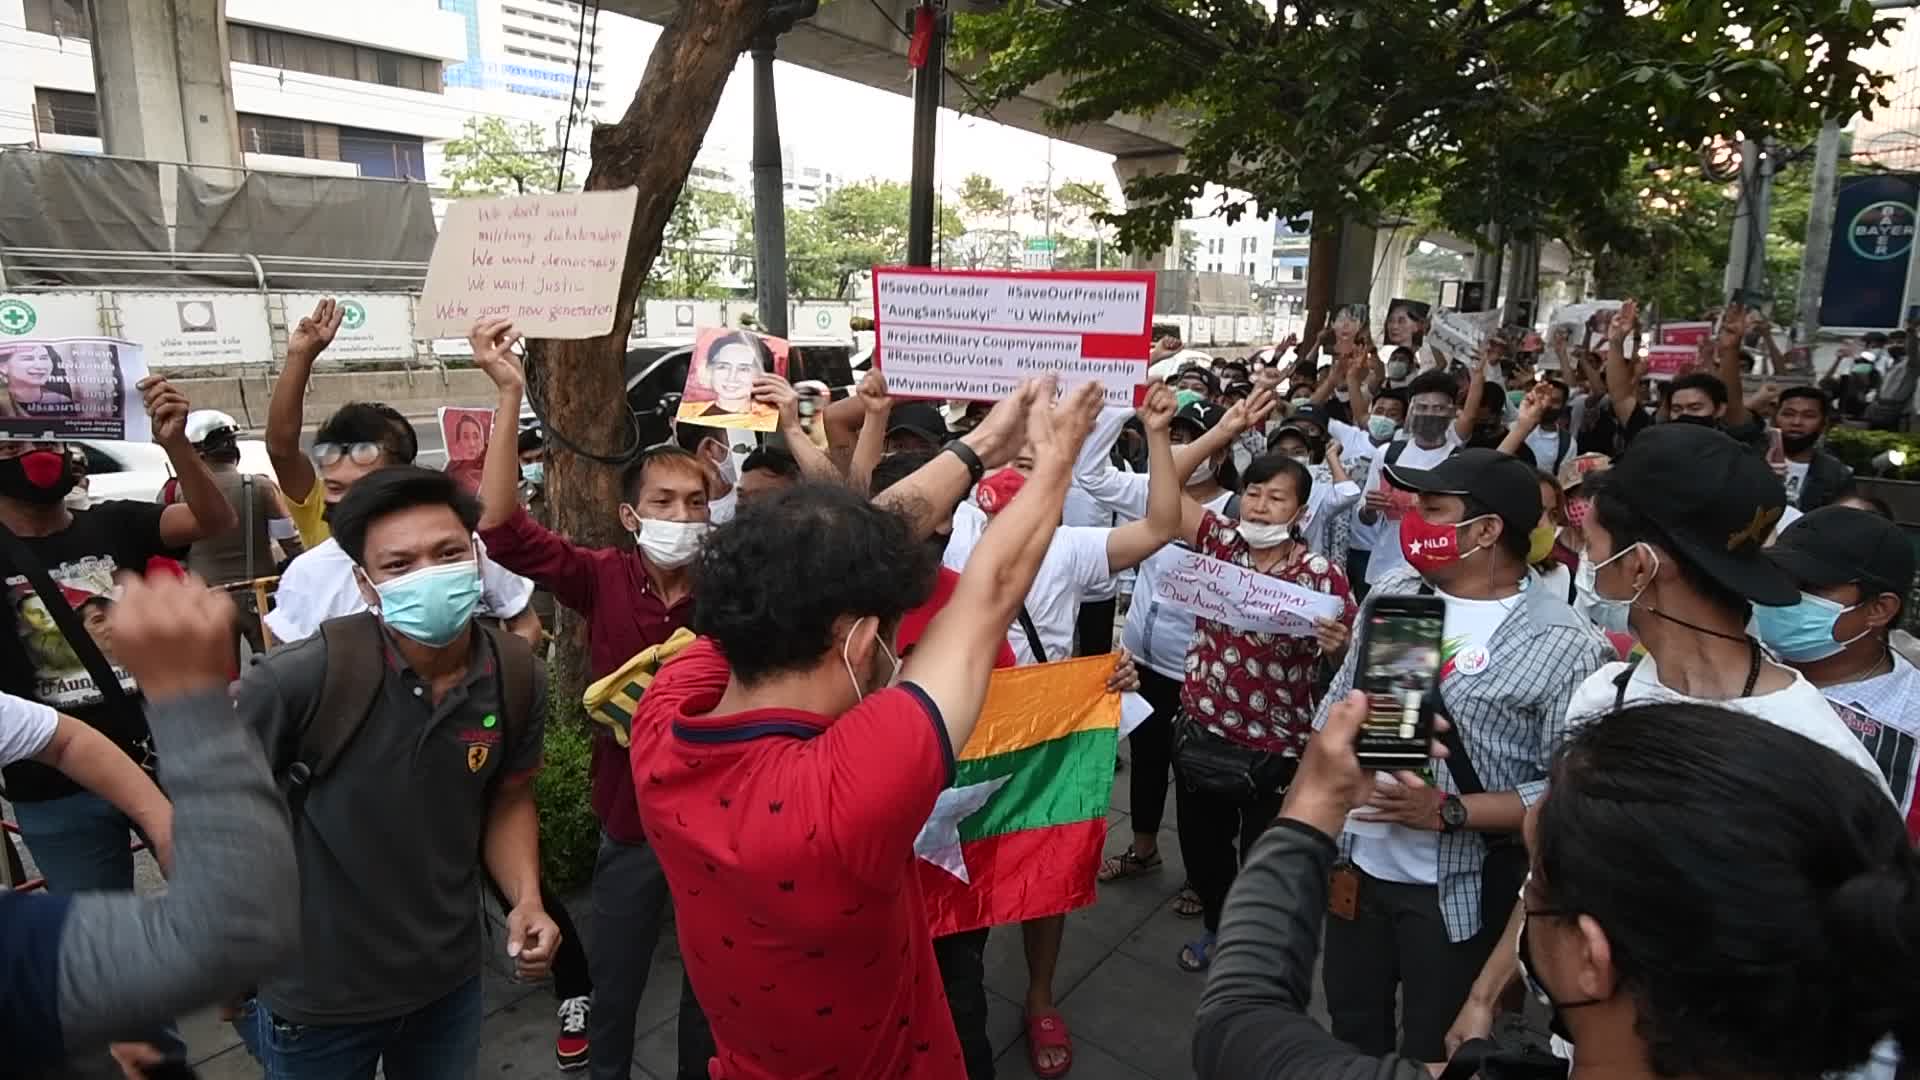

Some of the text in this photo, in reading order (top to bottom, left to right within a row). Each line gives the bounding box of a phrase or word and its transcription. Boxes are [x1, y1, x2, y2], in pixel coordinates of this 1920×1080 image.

[1856, 224, 1913, 236] BAYER
[472, 247, 494, 267] We
[502, 252, 535, 266] want
[467, 272, 486, 292] We
[494, 273, 526, 291] want
[881, 282, 1140, 302] #SaveOurLeader #SaveOurPresident
[886, 330, 1078, 351] #rejectMilitary Coupmyanmar
[887, 350, 1135, 376] #RespectOurVotes #StopDictatorship
[888, 376, 989, 394] #MyanmarWant
[1424, 537, 1449, 549] NLD
[1178, 554, 1310, 608] SAVE Myanmar
[1157, 582, 1189, 602] Daw
[1193, 589, 1228, 619] Aung
